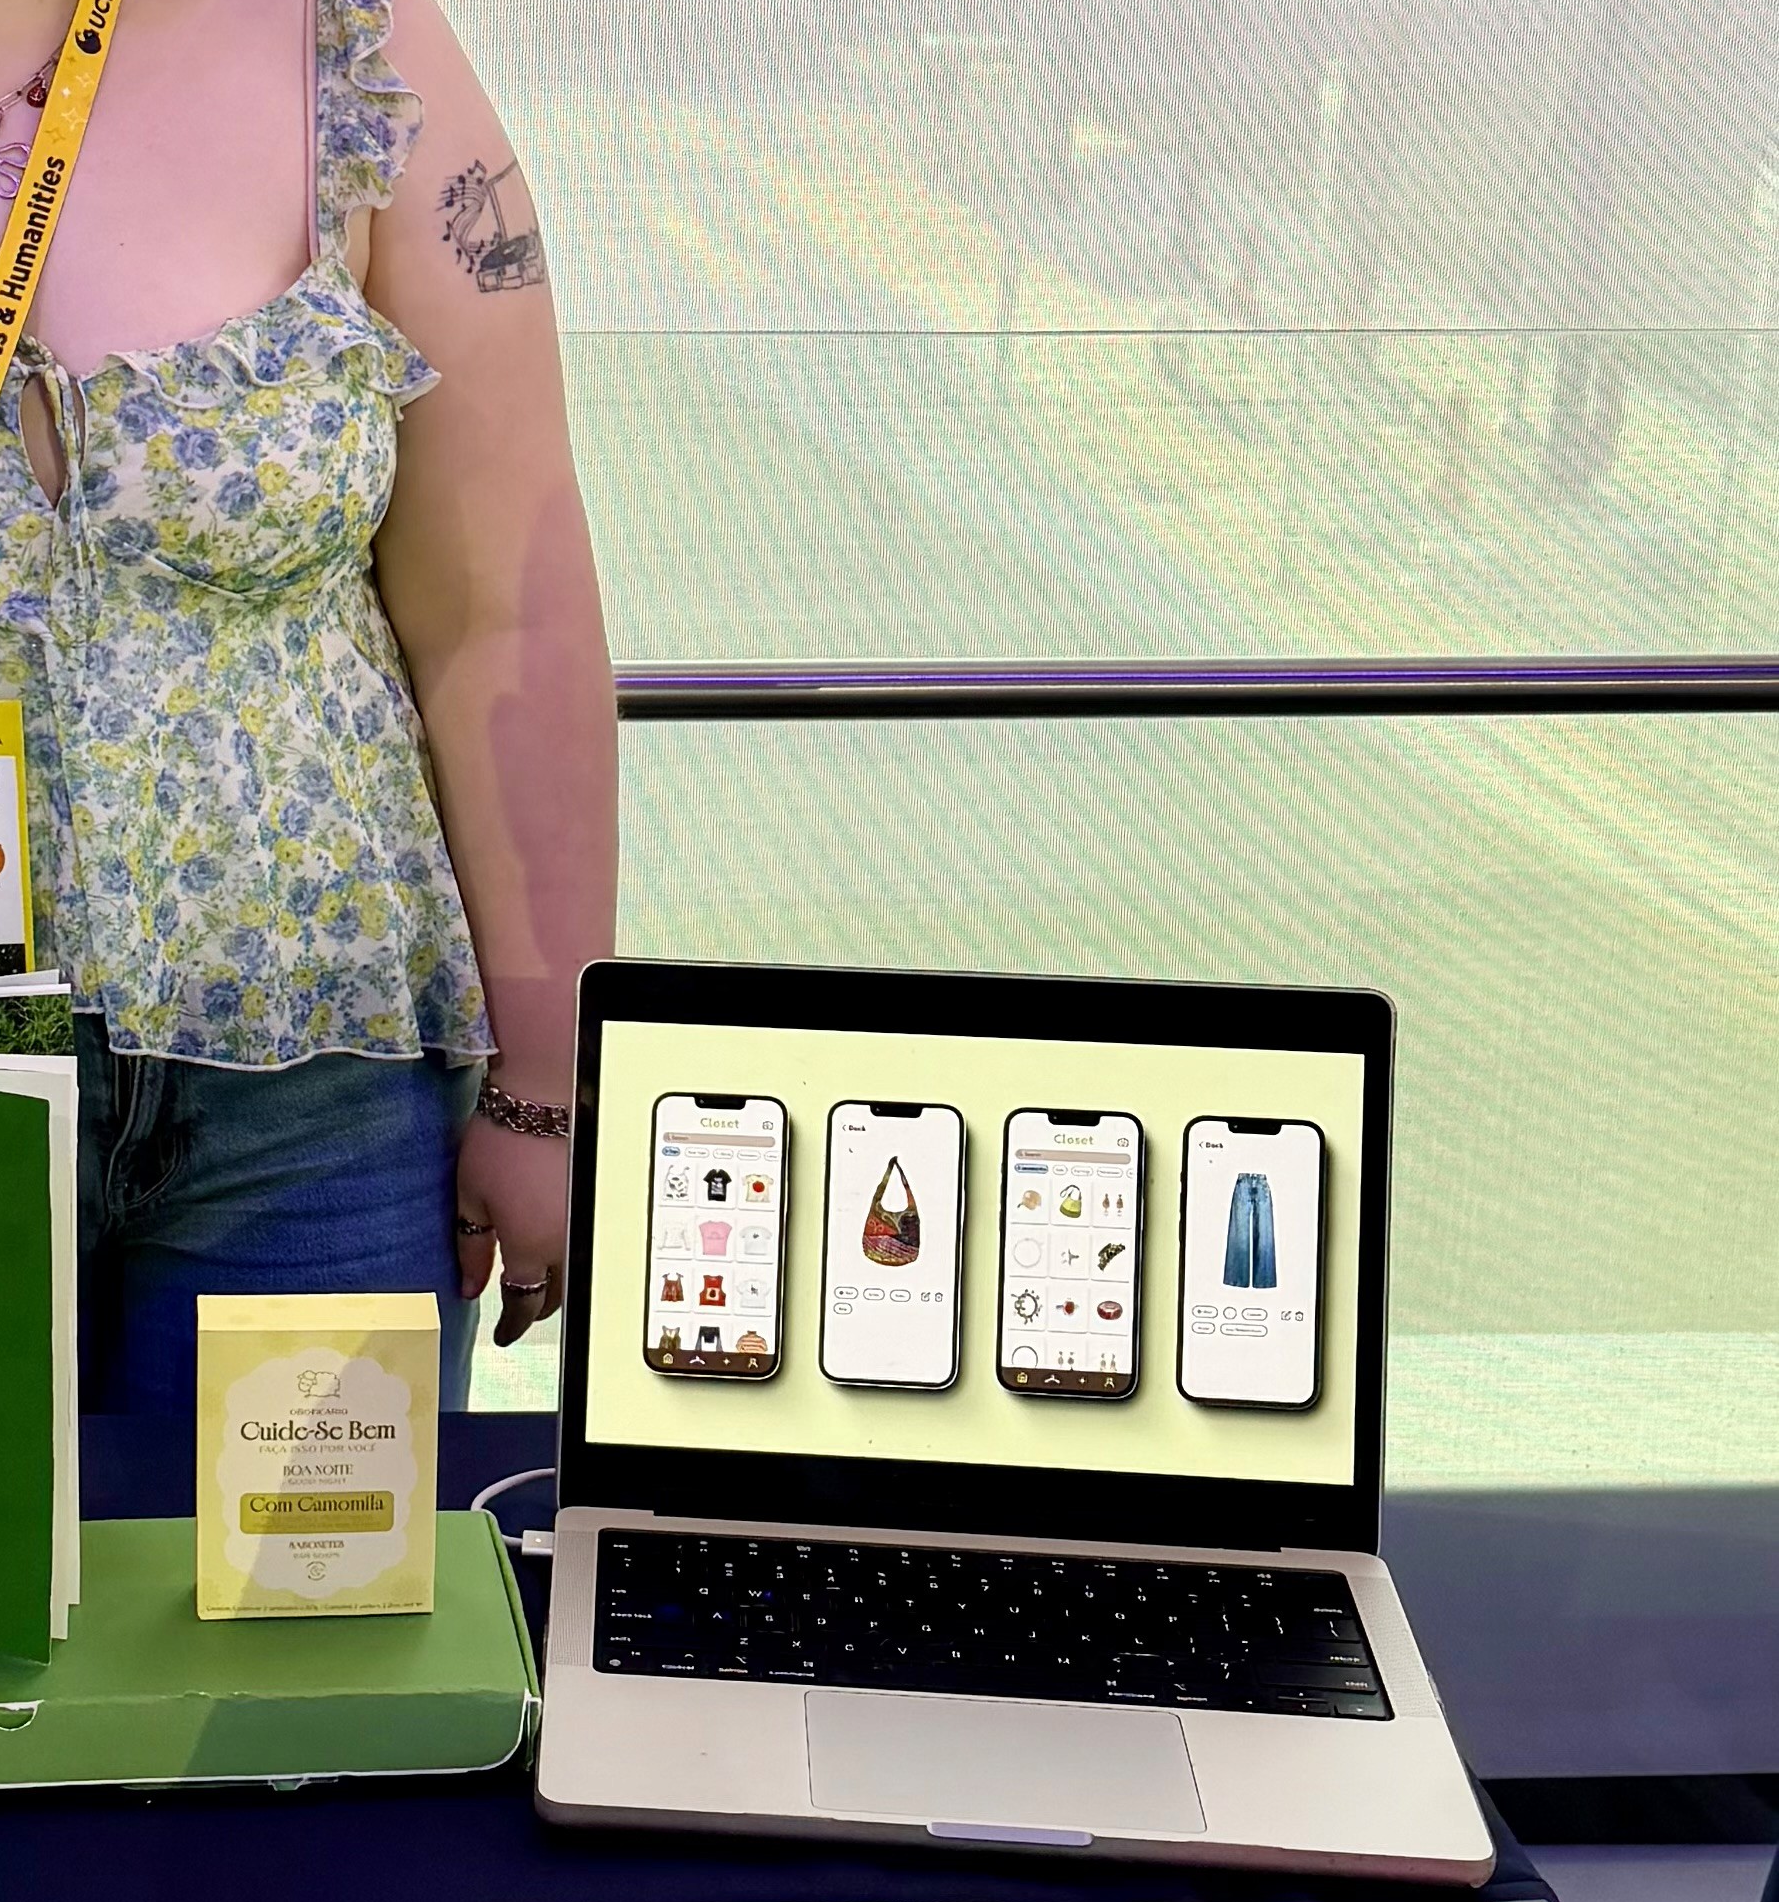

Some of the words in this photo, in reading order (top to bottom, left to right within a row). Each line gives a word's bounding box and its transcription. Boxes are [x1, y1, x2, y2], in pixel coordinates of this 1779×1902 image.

[0, 156, 65, 301] Humanities
[700, 1118, 739, 1129] Closet
[1054, 1133, 1094, 1145] Closet
[349, 1420, 396, 1441] Bem
[283, 1464, 311, 1476] BOA
[315, 1464, 354, 1476] NOITE
[250, 1497, 292, 1513] Com
[297, 1494, 384, 1512] Camomila
